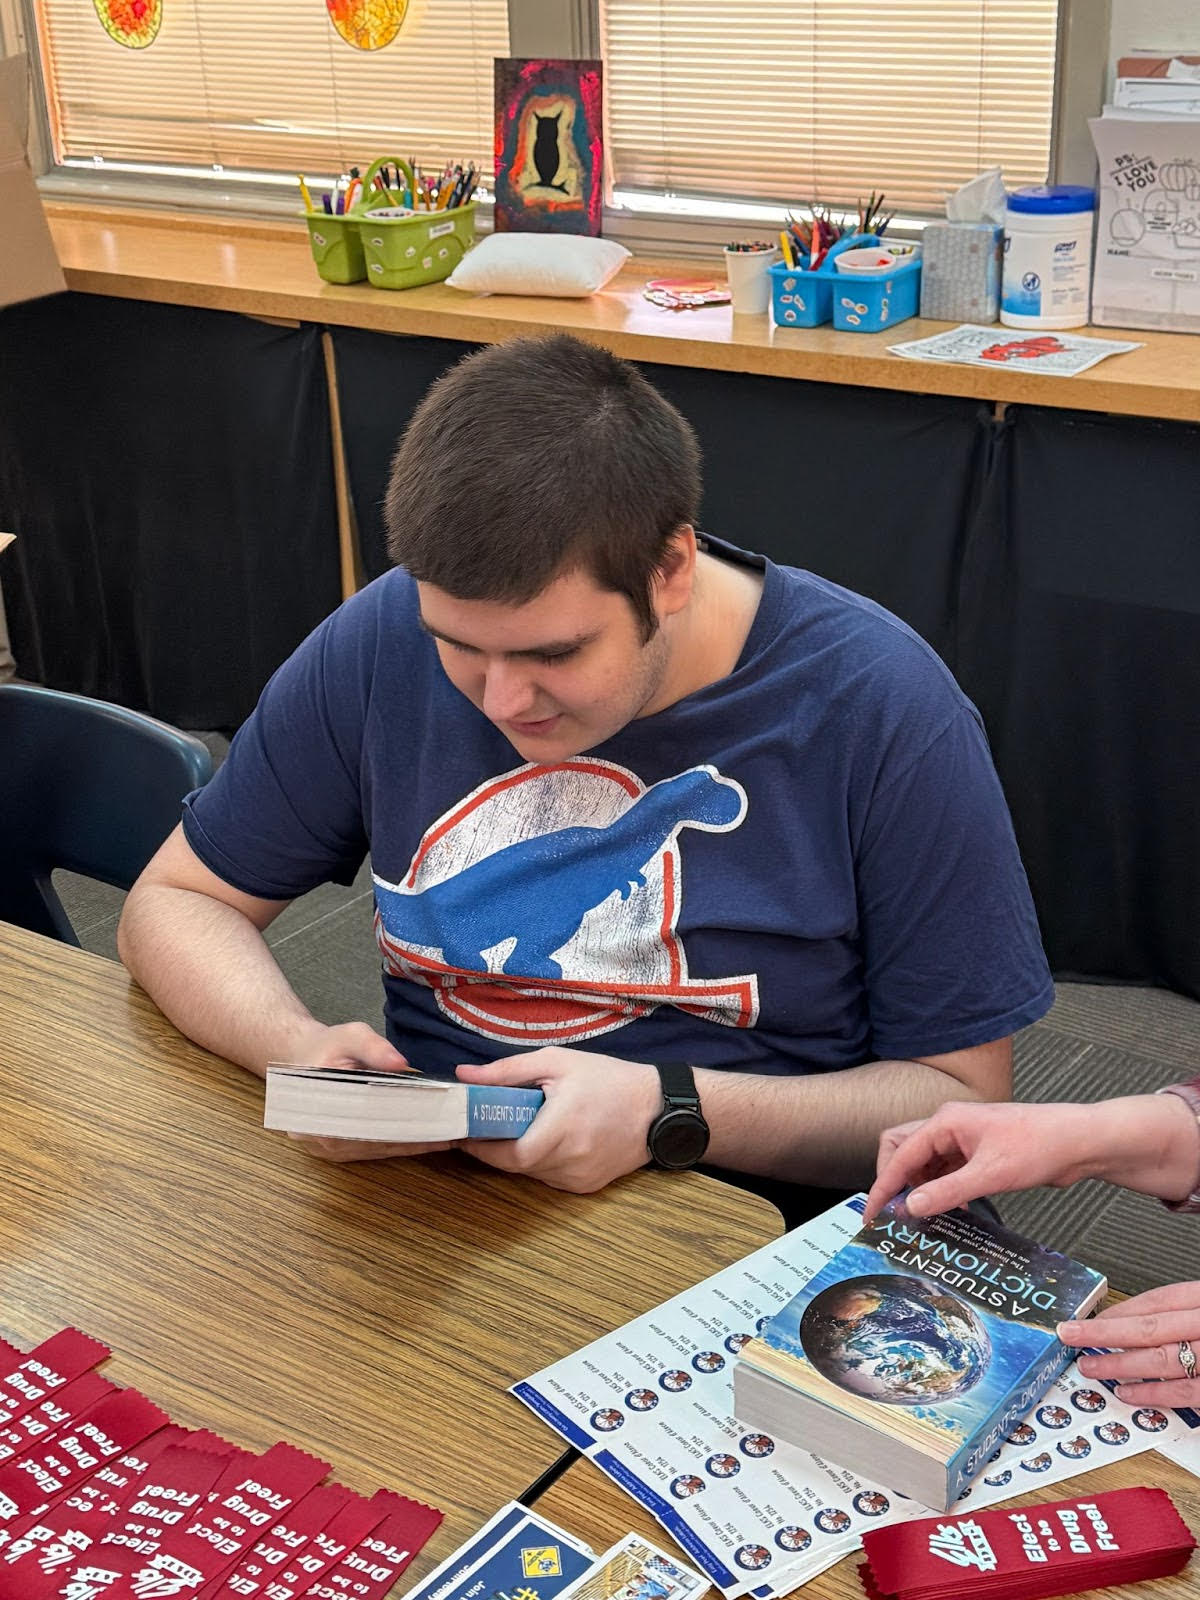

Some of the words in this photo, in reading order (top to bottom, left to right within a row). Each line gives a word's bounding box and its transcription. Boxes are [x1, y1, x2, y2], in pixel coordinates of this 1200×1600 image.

[1115, 176, 1122, 186] I
[1123, 160, 1158, 181] LOVE
[1127, 172, 1156, 192] YOU
[473, 1105, 479, 1120] A
[875, 1219, 1057, 1312] DICTIONARY
[876, 1240, 1007, 1308] STUDENT'S
[1010, 1302, 1031, 1317] A
[18, 1359, 66, 1387] Free!
[3, 1372, 45, 1400] Drug
[5, 1398, 19, 1408] to
[40, 1401, 71, 1422] Fre
[956, 1473, 964, 1486] A
[1021, 1345, 1069, 1408] DICTIONAR
[8, 1433, 22, 1443] to
[74, 1422, 122, 1456] Free!
[44, 1455, 61, 1468] be
[58, 1436, 98, 1469] Drug
[17, 1459, 63, 1493] Elect
[57, 1465, 71, 1476] to
[137, 1484, 200, 1516] Free!
[235, 1479, 292, 1510] Free!
[128, 1493, 184, 1524] Drug
[221, 1495, 272, 1526] Drug
[124, 1523, 145, 1534] be
[145, 1527, 162, 1537] to
[212, 1516, 231, 1529] be
[230, 1525, 246, 1536] to
[1038, 1520, 1053, 1536] be
[1056, 1510, 1092, 1554] Drug
[1077, 1503, 1120, 1551] Free!
[100, 1532, 160, 1555] Elect
[185, 1523, 242, 1555] Elect
[271, 1525, 308, 1547] Fre
[313, 1533, 346, 1556] Fre
[1008, 1513, 1048, 1562] Elect
[1048, 1538, 1061, 1552] to
[360, 1537, 410, 1563] Free
[246, 1564, 262, 1575] to
[296, 1554, 325, 1573] Dr
[228, 1573, 259, 1595] Ele
[283, 1571, 298, 1583] to
[331, 1575, 352, 1588] be
[306, 1583, 357, 1600] ect
[353, 1583, 369, 1594] to
[464, 1579, 487, 1600] Join
